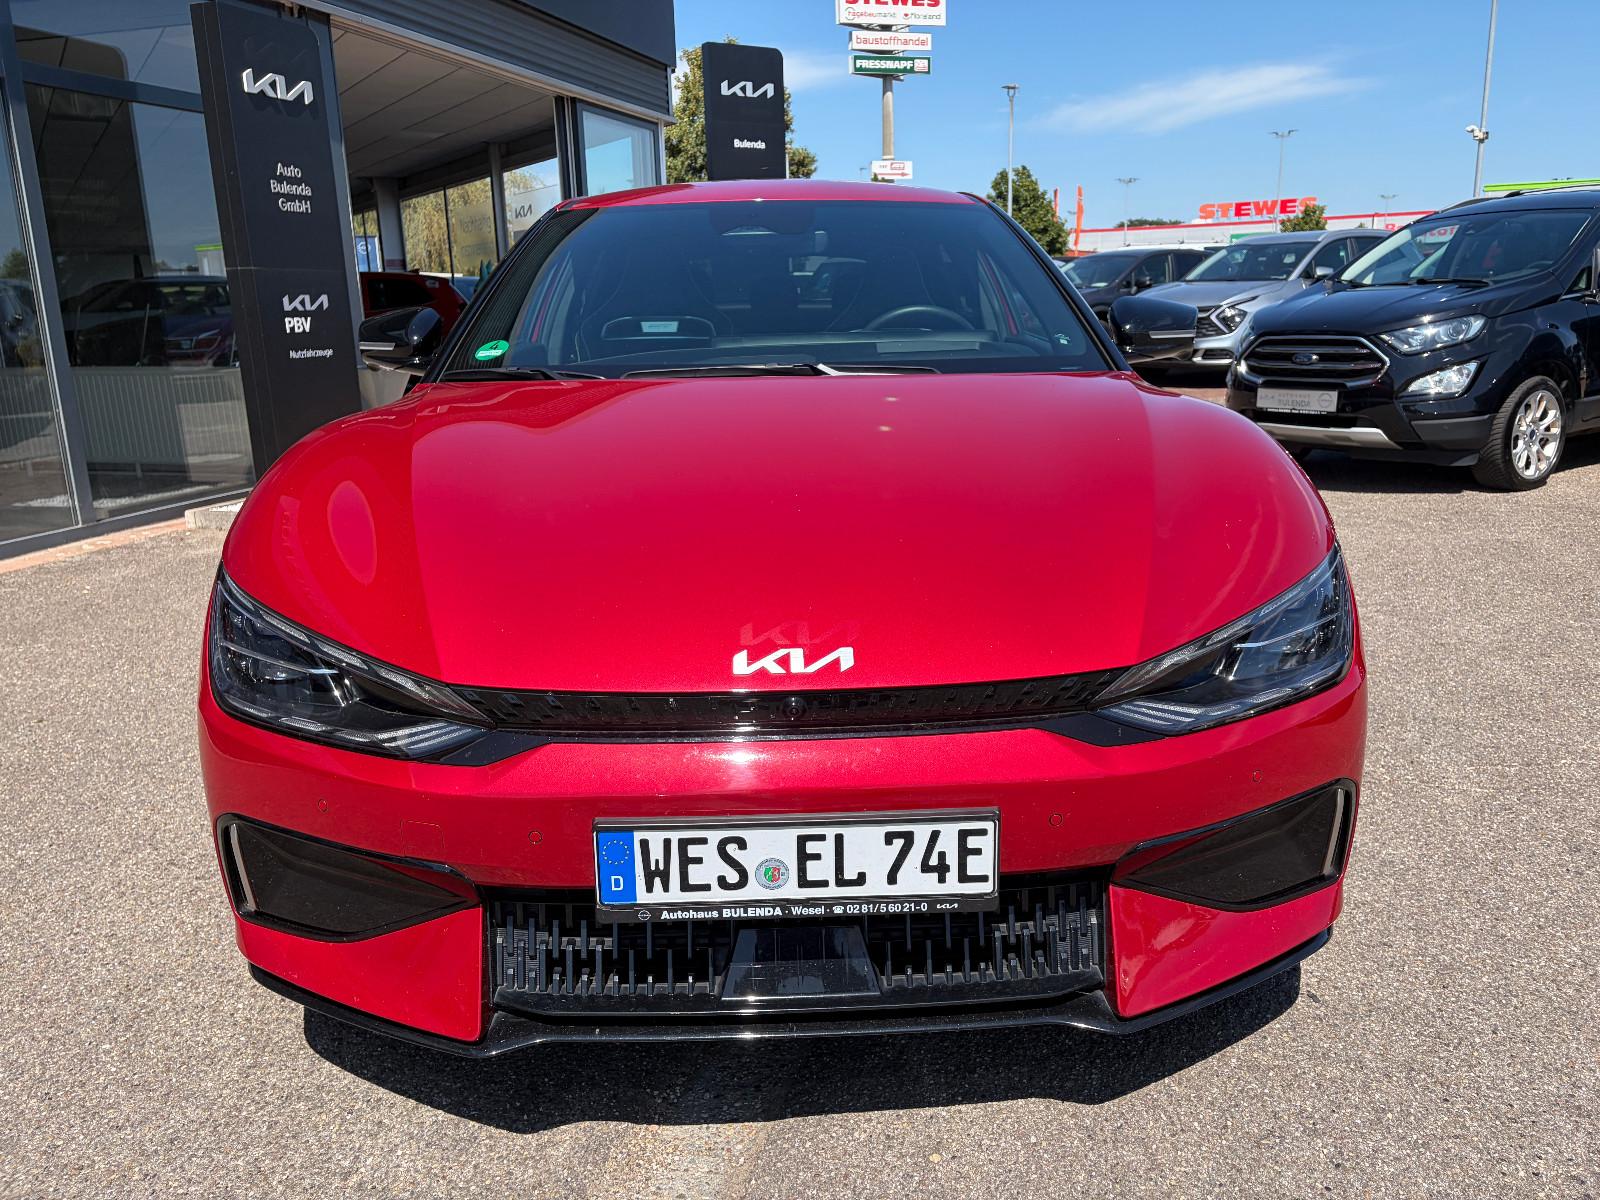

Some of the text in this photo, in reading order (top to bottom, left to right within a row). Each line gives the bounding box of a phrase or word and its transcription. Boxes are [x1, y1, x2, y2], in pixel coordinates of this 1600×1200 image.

[855, 35, 929, 47] baustoffhandel
[855, 59, 914, 70] FRESSNAPF
[242, 68, 314, 105] KIA
[720, 79, 775, 99] KIA
[733, 138, 766, 150] Bulenda
[276, 162, 302, 178] Auto
[269, 179, 312, 197] Bulenda
[278, 198, 312, 214] GmbH
[282, 293, 329, 312] KIA
[284, 316, 312, 334] PBV
[732, 646, 855, 675] KIA
[639, 836, 749, 894] WES
[796, 833, 867, 889] EL
[884, 828, 989, 886] 74E
[610, 875, 624, 891] D
[660, 909, 720, 921] Autohaus
[722, 906, 783, 919] BULENDA
[790, 903, 825, 916] Wesel
